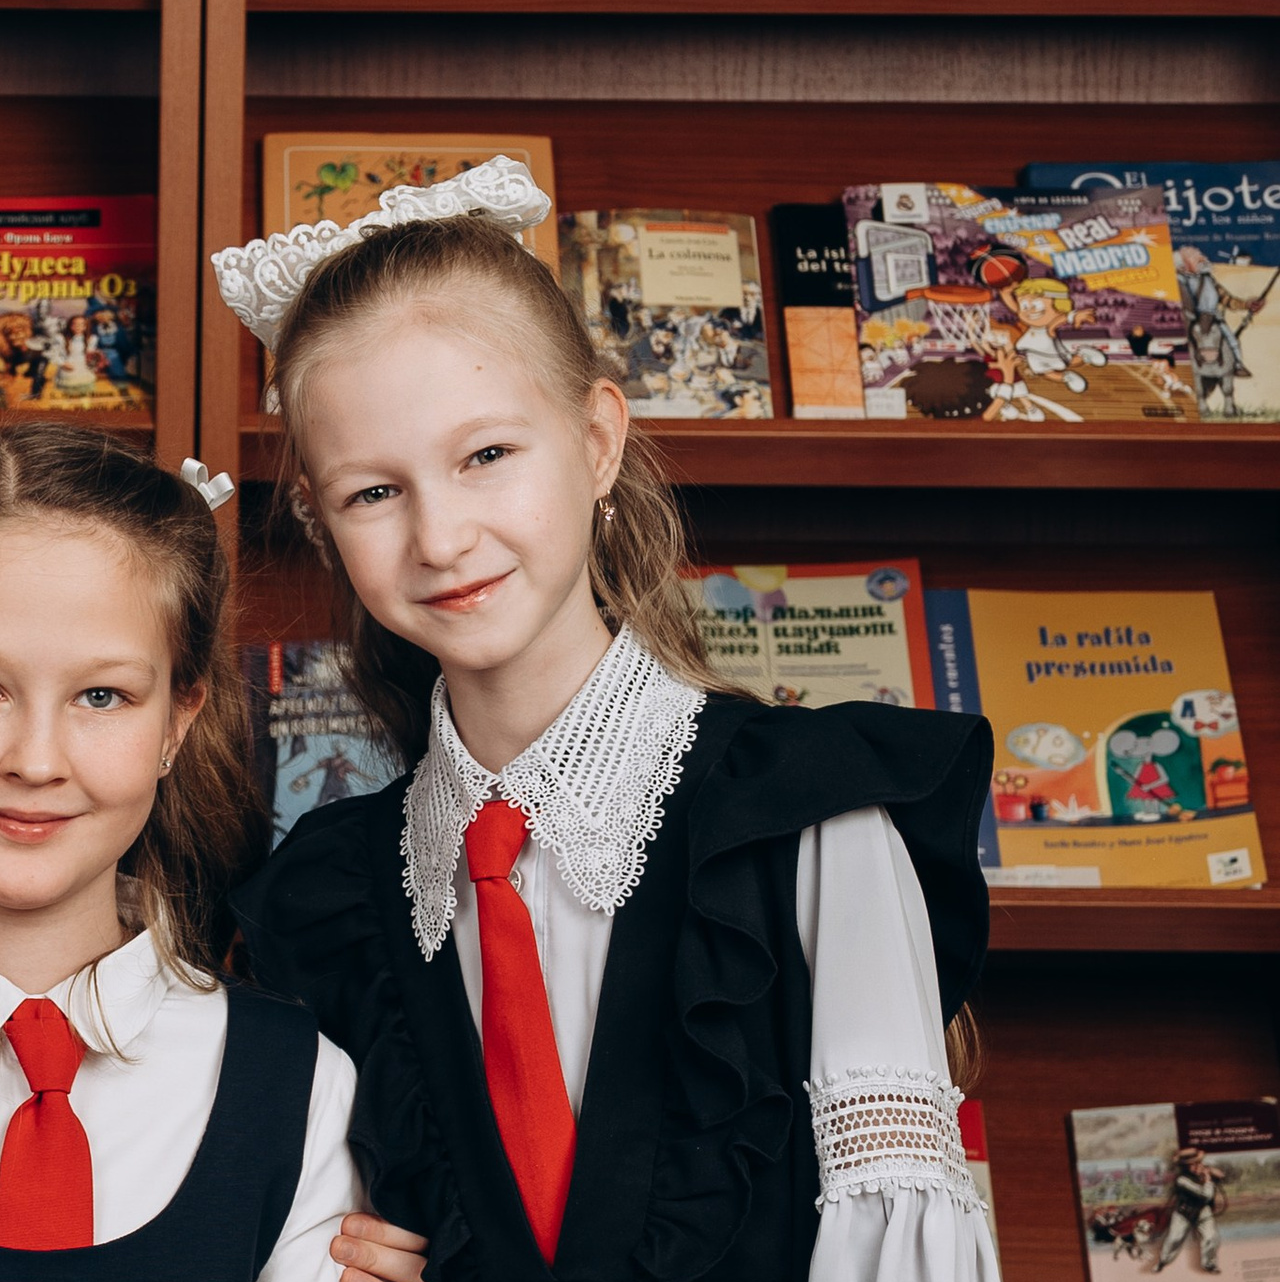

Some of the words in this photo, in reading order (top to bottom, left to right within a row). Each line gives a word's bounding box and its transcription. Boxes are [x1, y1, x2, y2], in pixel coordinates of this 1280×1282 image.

[647, 247, 665, 260] La
[669, 248, 733, 263] colmena
[795, 246, 818, 260] La
[823, 246, 848, 260] isl
[796, 258, 828, 273] del
[99, 272, 138, 299] Оз
[1037, 625, 1068, 647] La
[1076, 625, 1152, 647] ratita
[1024, 654, 1174, 683] presumida
